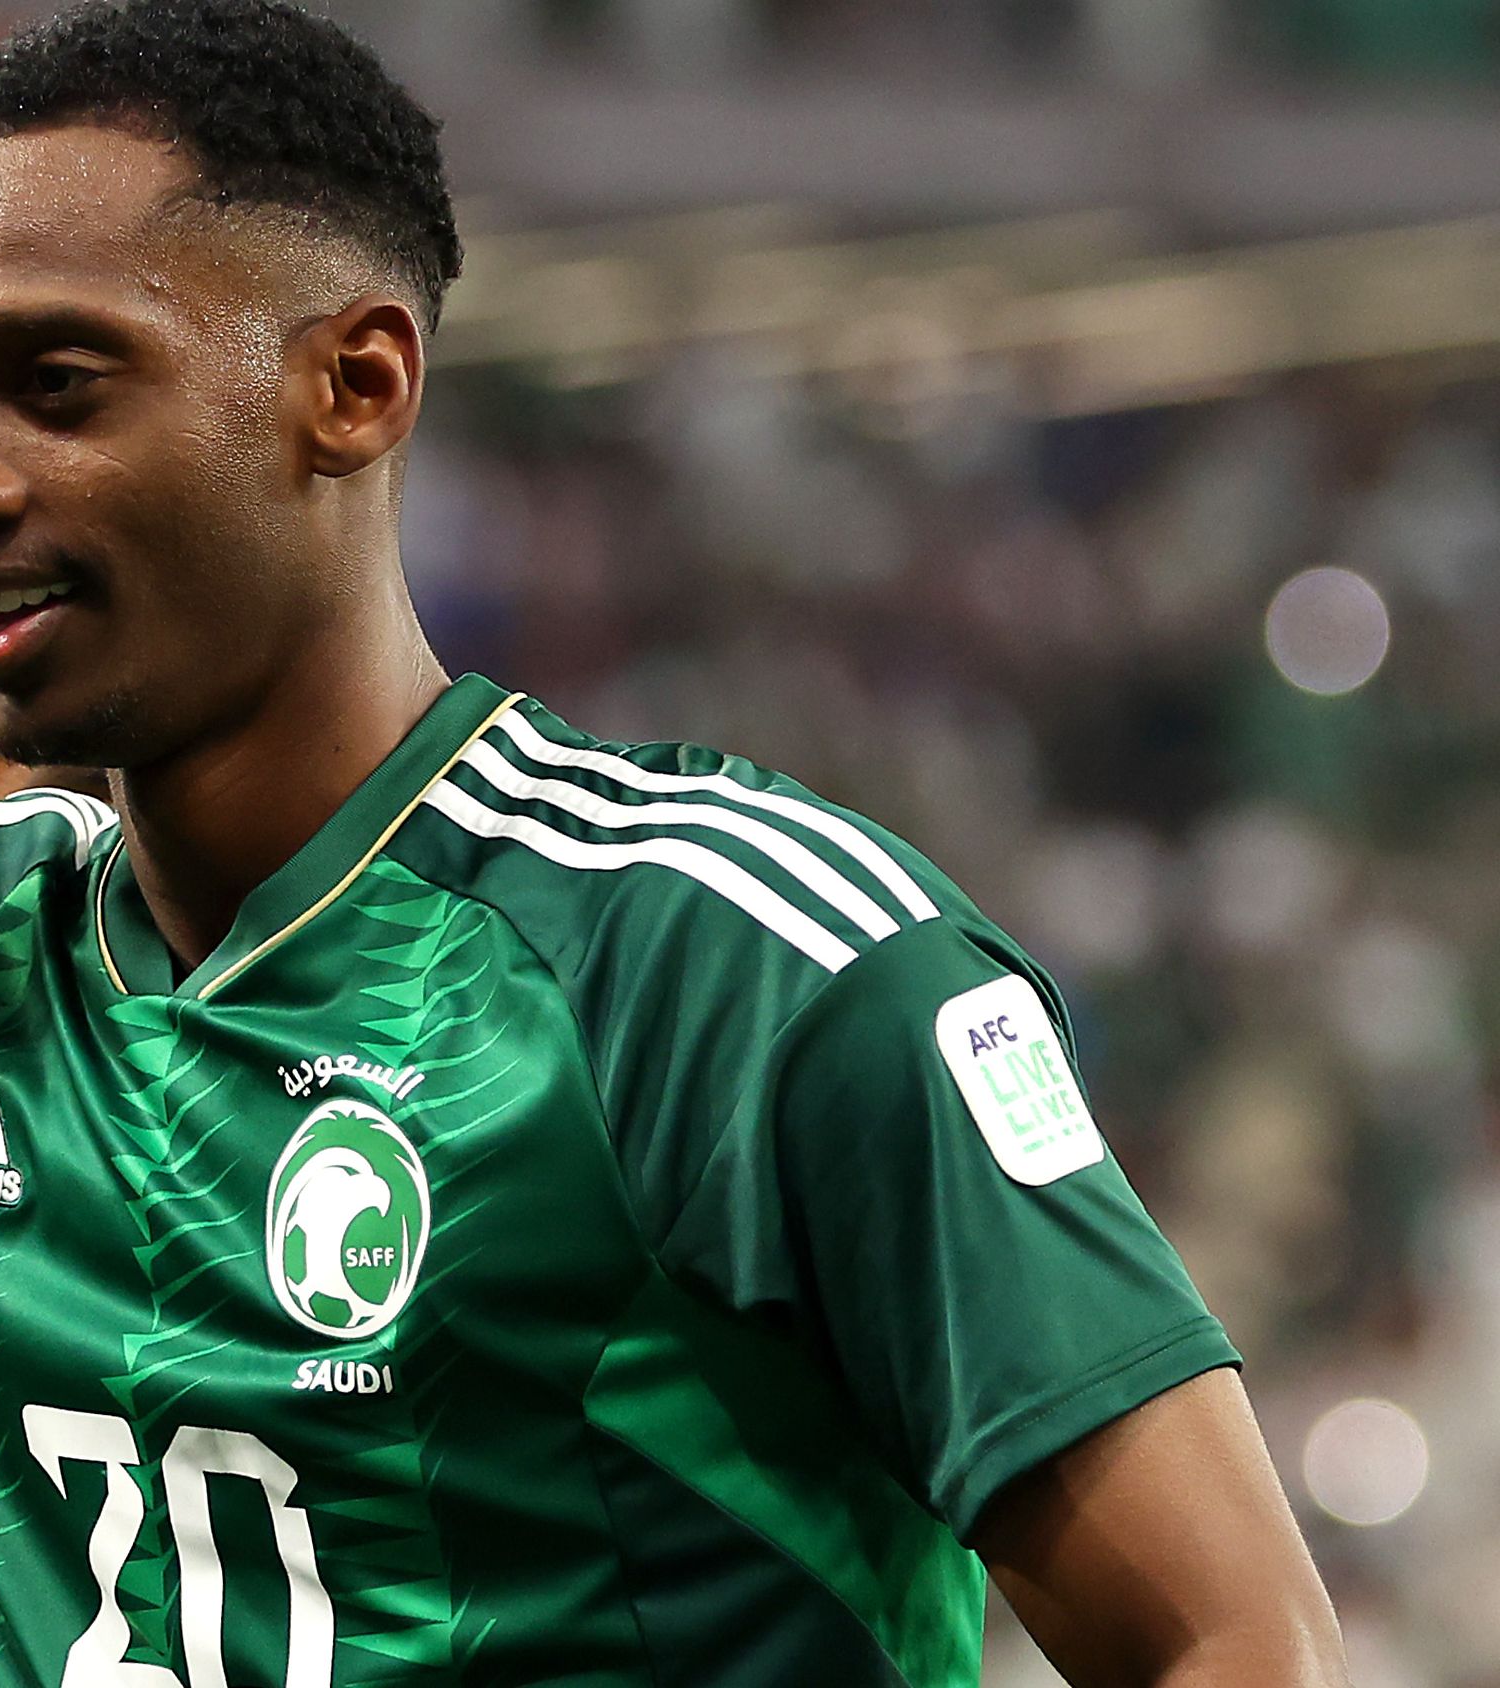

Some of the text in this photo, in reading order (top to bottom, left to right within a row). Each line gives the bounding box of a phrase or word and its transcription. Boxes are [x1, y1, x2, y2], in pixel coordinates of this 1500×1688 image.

[967, 1015, 1018, 1057] AFC
[277, 1054, 425, 1100] السعودية
[979, 1039, 1064, 1107] LIVE
[345, 1247, 395, 1268] SAFF
[291, 1359, 394, 1394] SAUDI
[22, 1404, 335, 1688] 20
